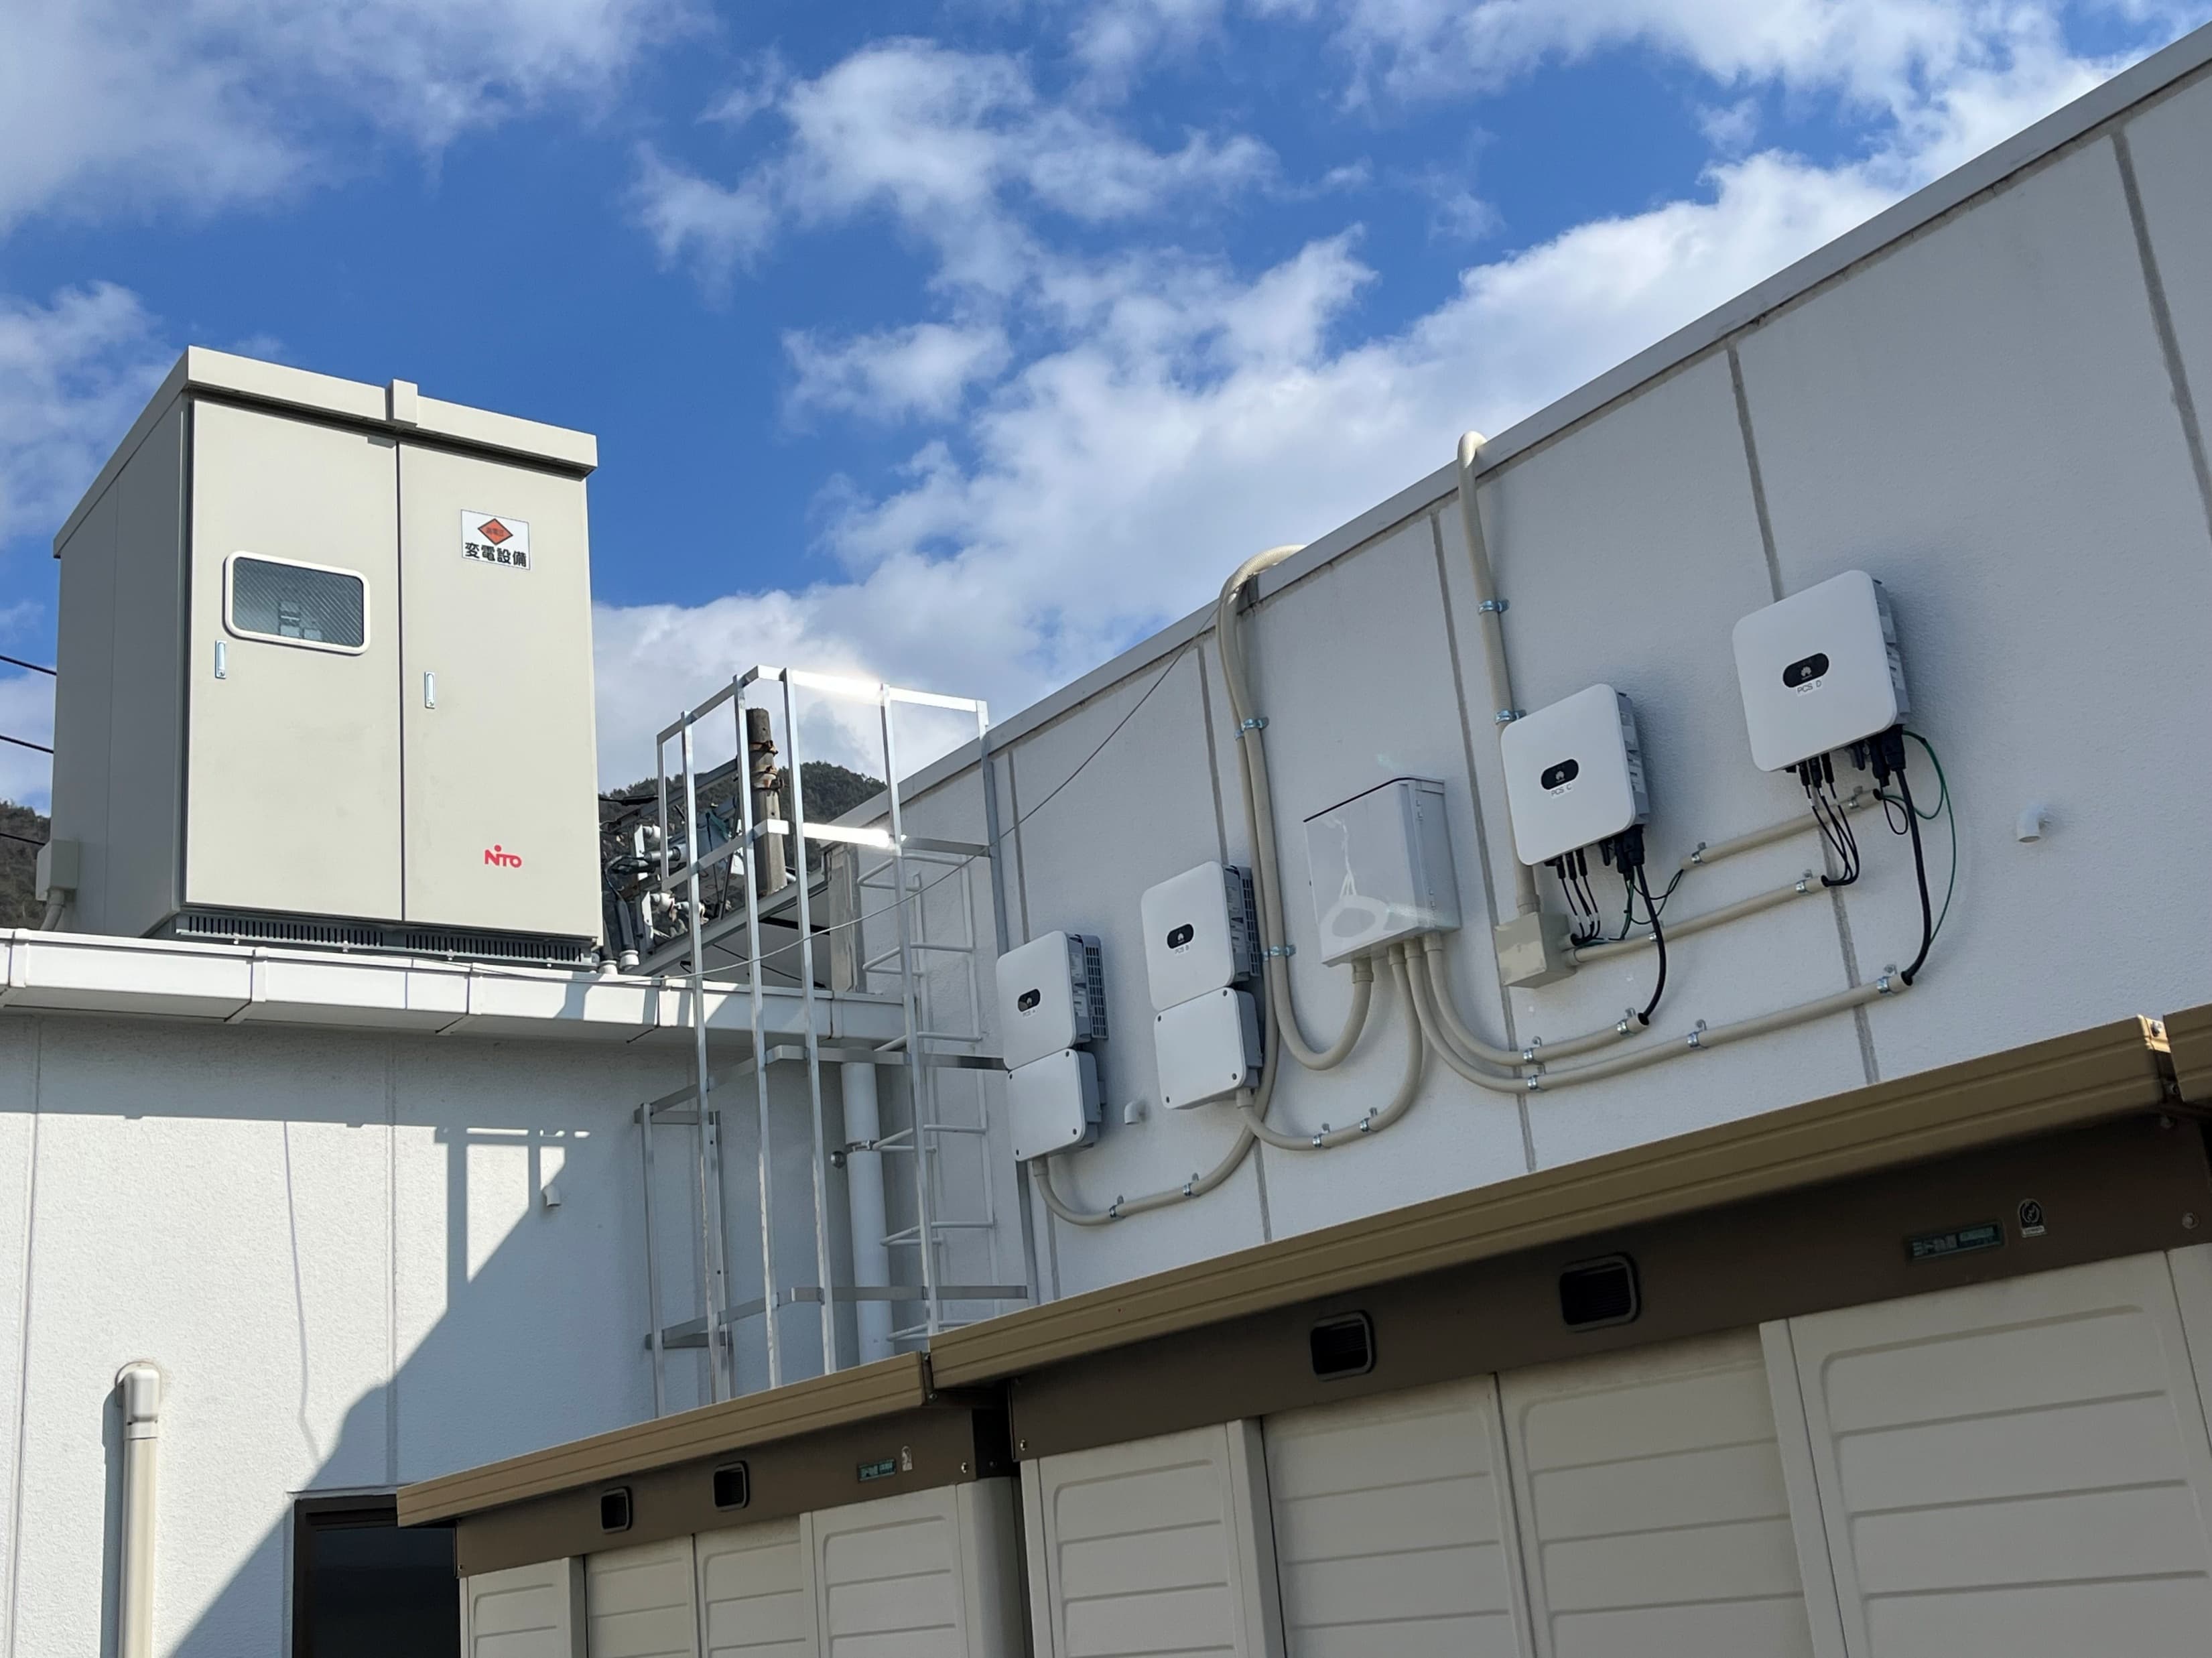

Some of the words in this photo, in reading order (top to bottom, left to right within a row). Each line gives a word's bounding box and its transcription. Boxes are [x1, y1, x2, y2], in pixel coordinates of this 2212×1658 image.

[465, 542, 526, 567] 変電設備
[1797, 683, 1813, 693] PCS
[1816, 680, 1822, 688] D
[1551, 786, 1564, 796] PCS
